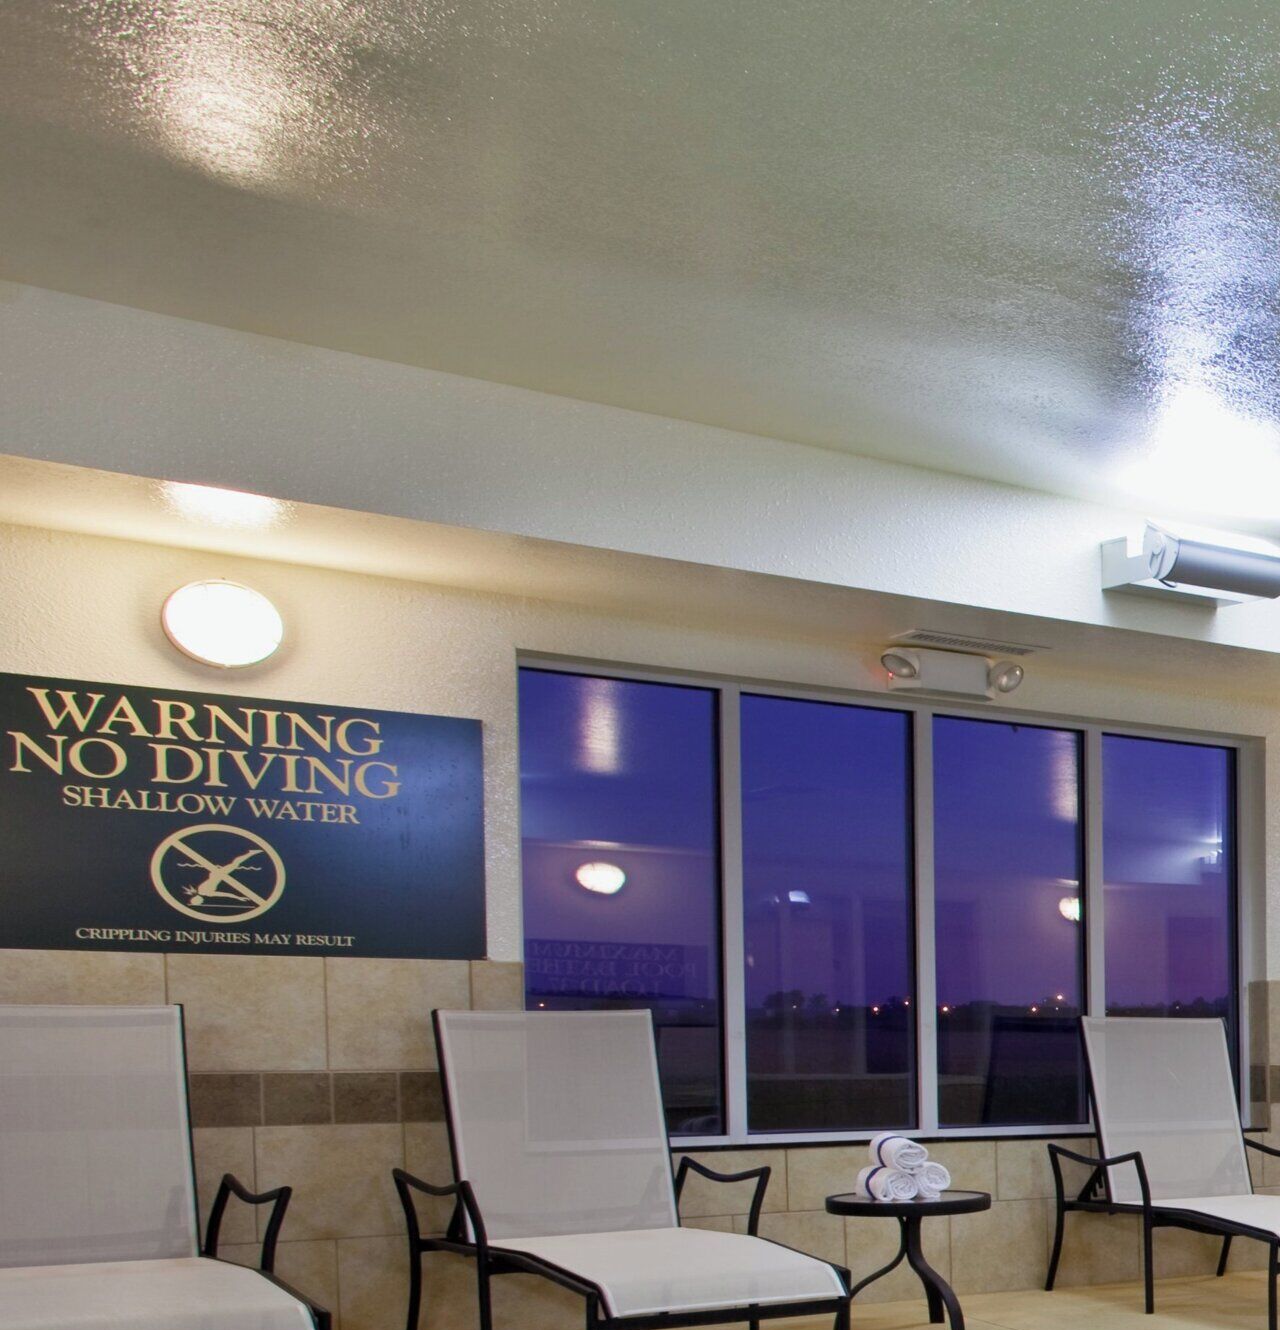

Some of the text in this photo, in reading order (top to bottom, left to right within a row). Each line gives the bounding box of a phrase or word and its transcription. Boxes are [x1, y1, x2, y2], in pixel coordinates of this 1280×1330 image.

[26, 687, 384, 757] WARNING
[7, 730, 402, 799] NO DIVING
[62, 785, 361, 825] SHALLOW WATER
[76, 926, 356, 948] CRIPPLING INJURIES MAY RESULT
